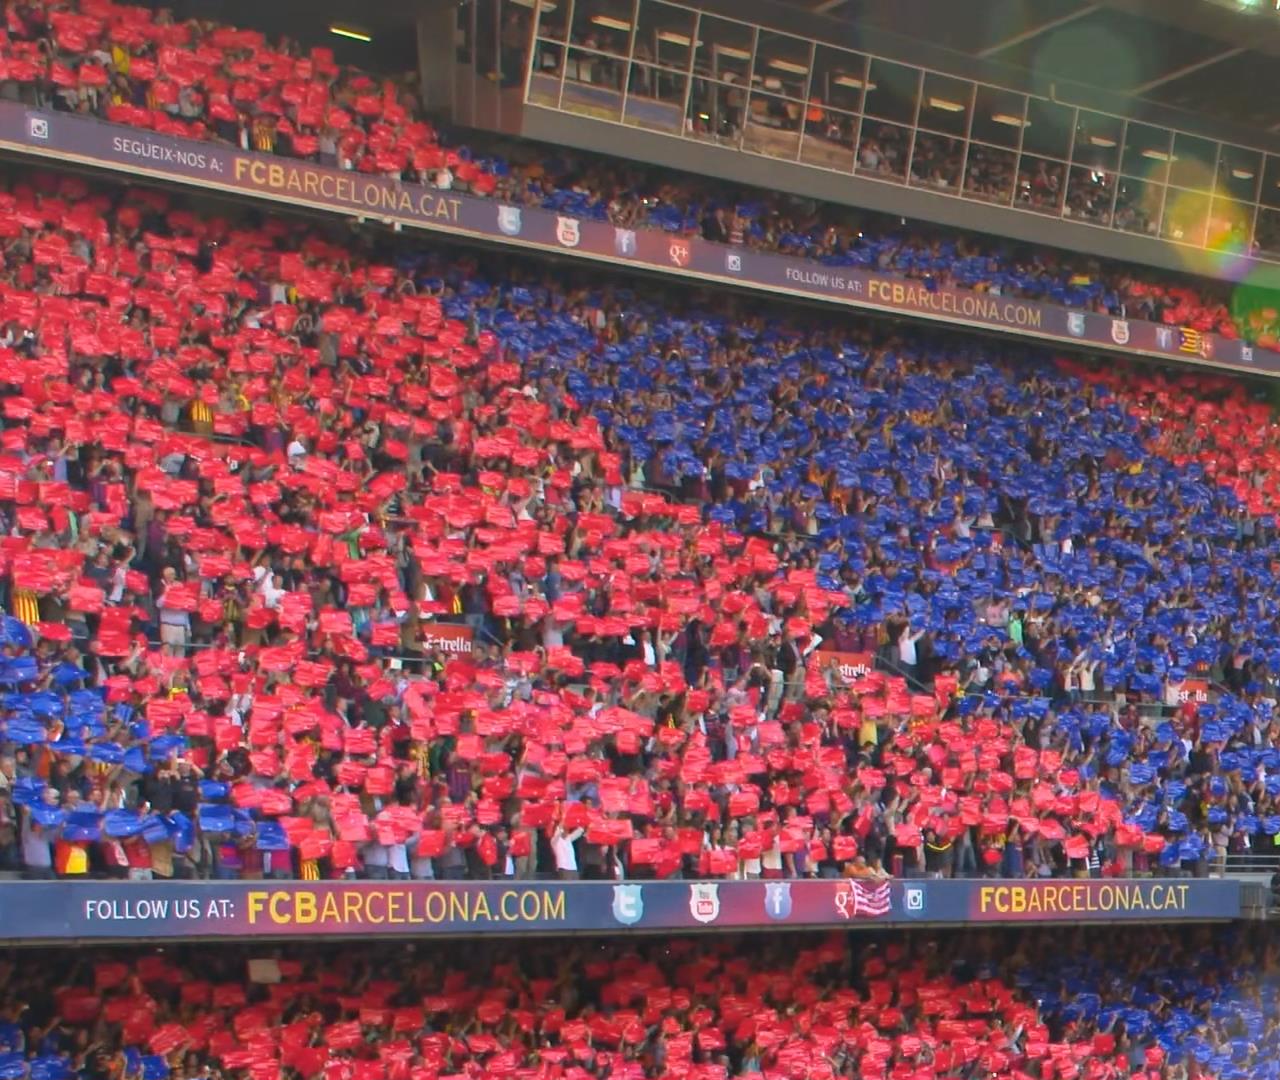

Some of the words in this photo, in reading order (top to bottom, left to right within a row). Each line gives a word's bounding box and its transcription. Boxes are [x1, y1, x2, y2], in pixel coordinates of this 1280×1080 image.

[235, 157, 461, 221] FCBARCELONA.CAT
[786, 267, 829, 288] FOLLOW
[831, 276, 846, 290] US
[868, 279, 1041, 328] FCBARCELONA.COM
[86, 899, 168, 921] FOLLOW
[175, 899, 200, 919] US
[207, 899, 234, 919] AT:
[248, 890, 566, 924] FCBARCELONA.COM
[981, 884, 1189, 912] FCBARCELONA.CAT
